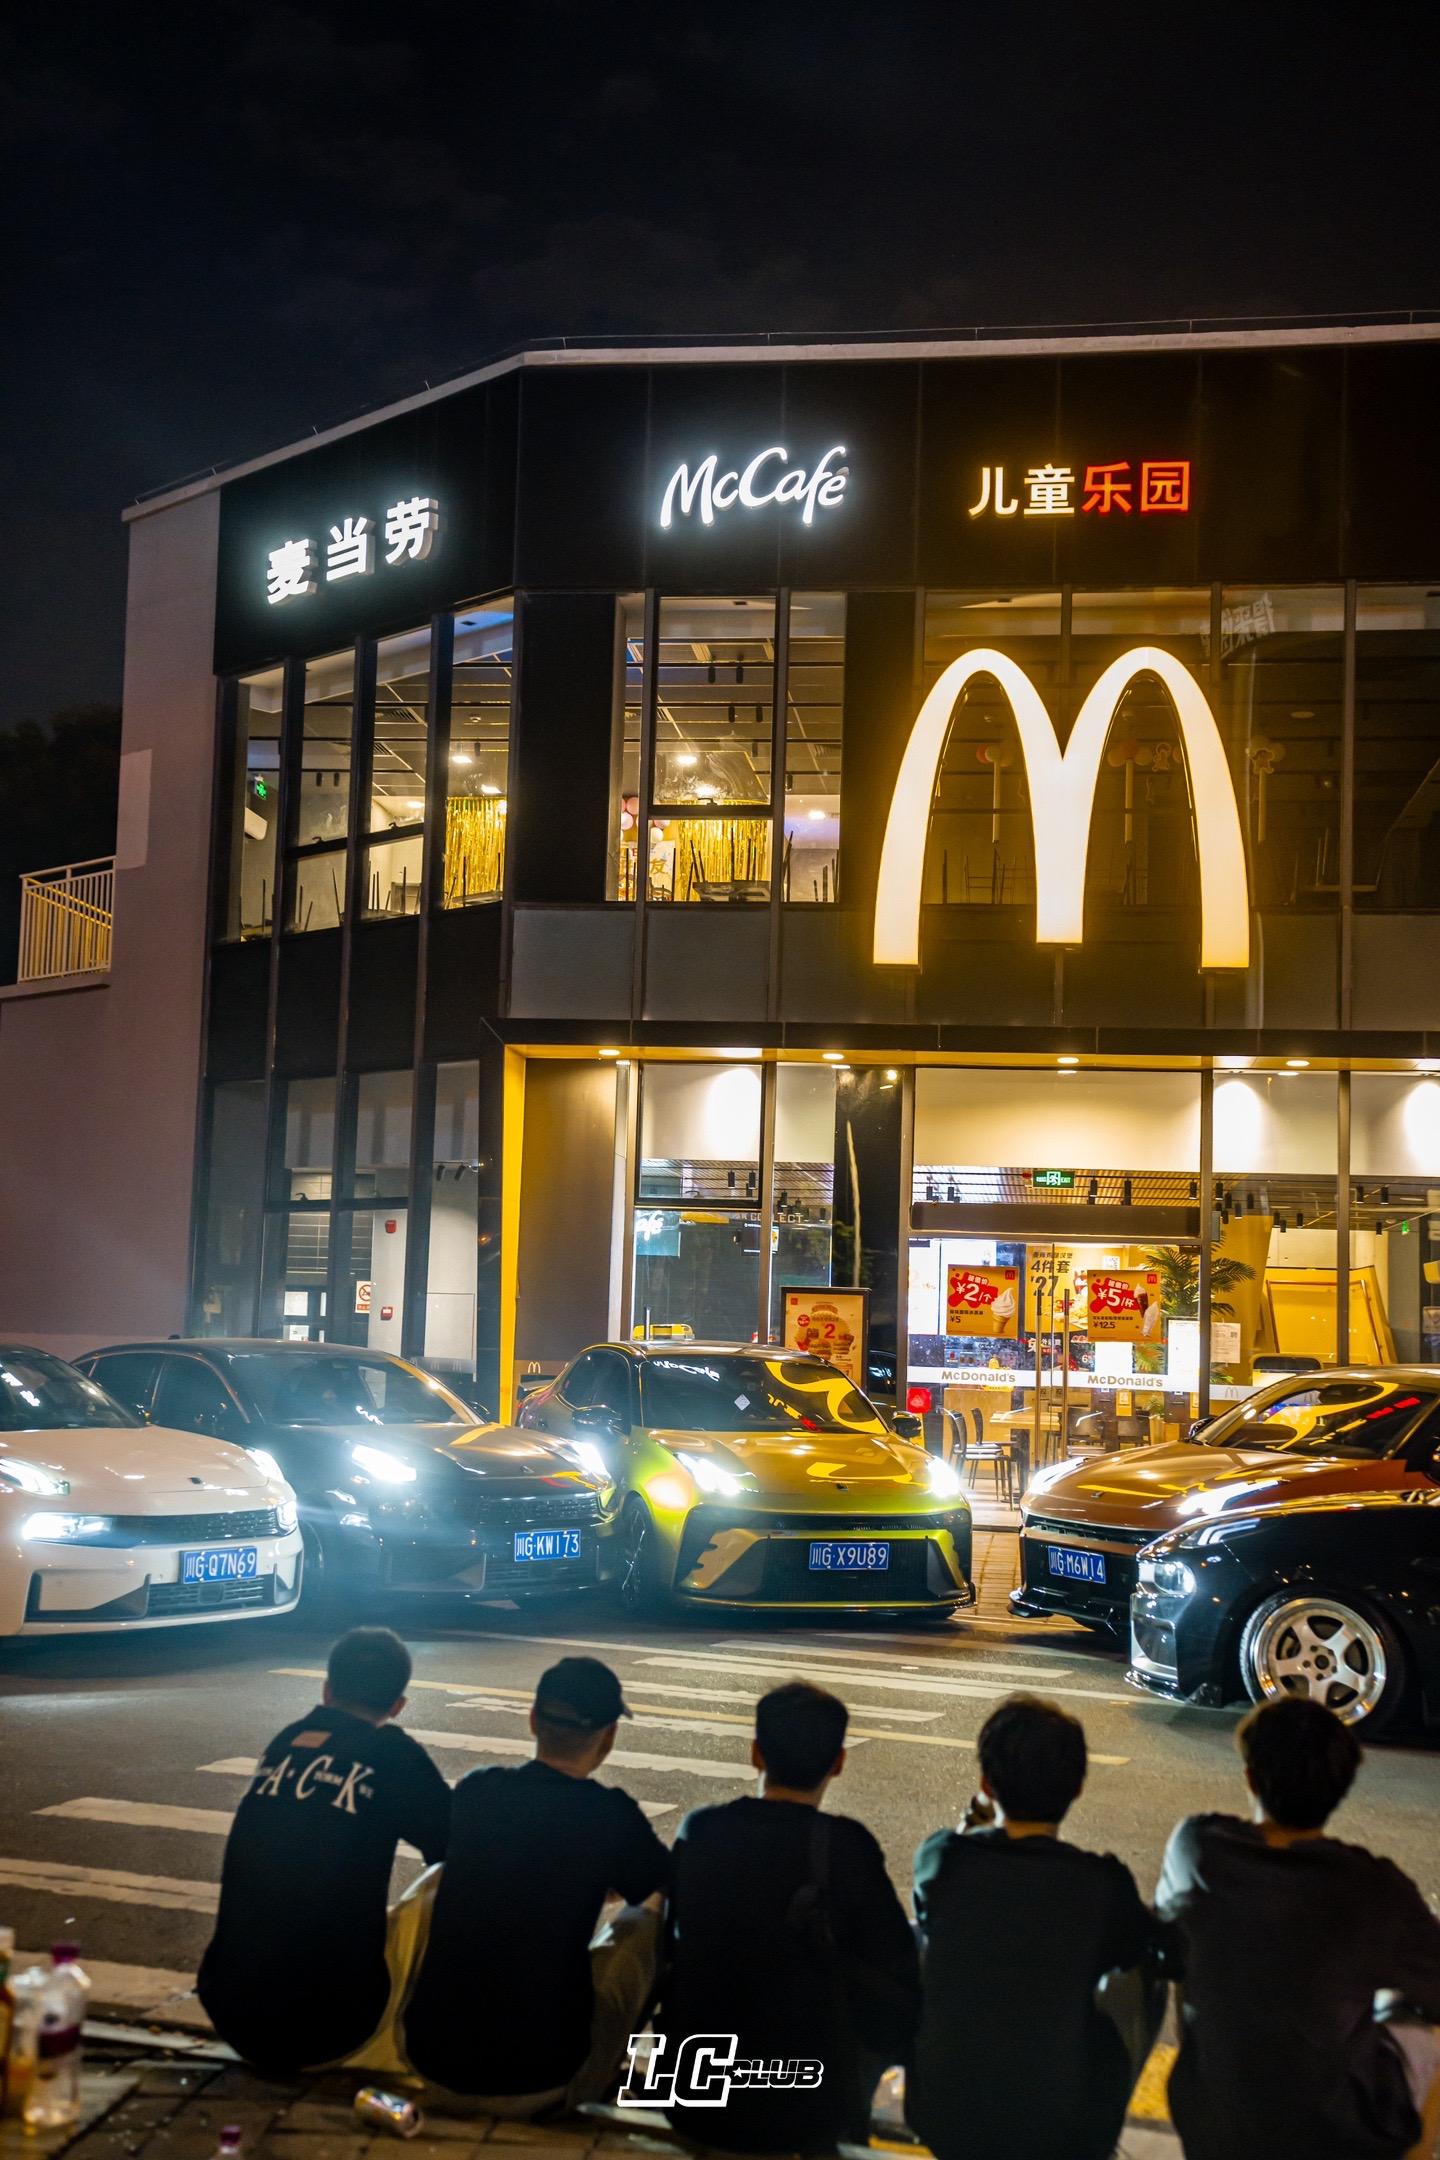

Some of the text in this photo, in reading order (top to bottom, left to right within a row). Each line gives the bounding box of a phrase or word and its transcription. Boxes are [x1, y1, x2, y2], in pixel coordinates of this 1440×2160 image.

[660, 446, 850, 528] McCafé
[968, 461, 1191, 517] 儿童乐园
[266, 496, 438, 605] 麦当劳
[941, 1370, 1016, 1383] McDonald's
[1087, 1375, 1163, 1387] McDonald's
